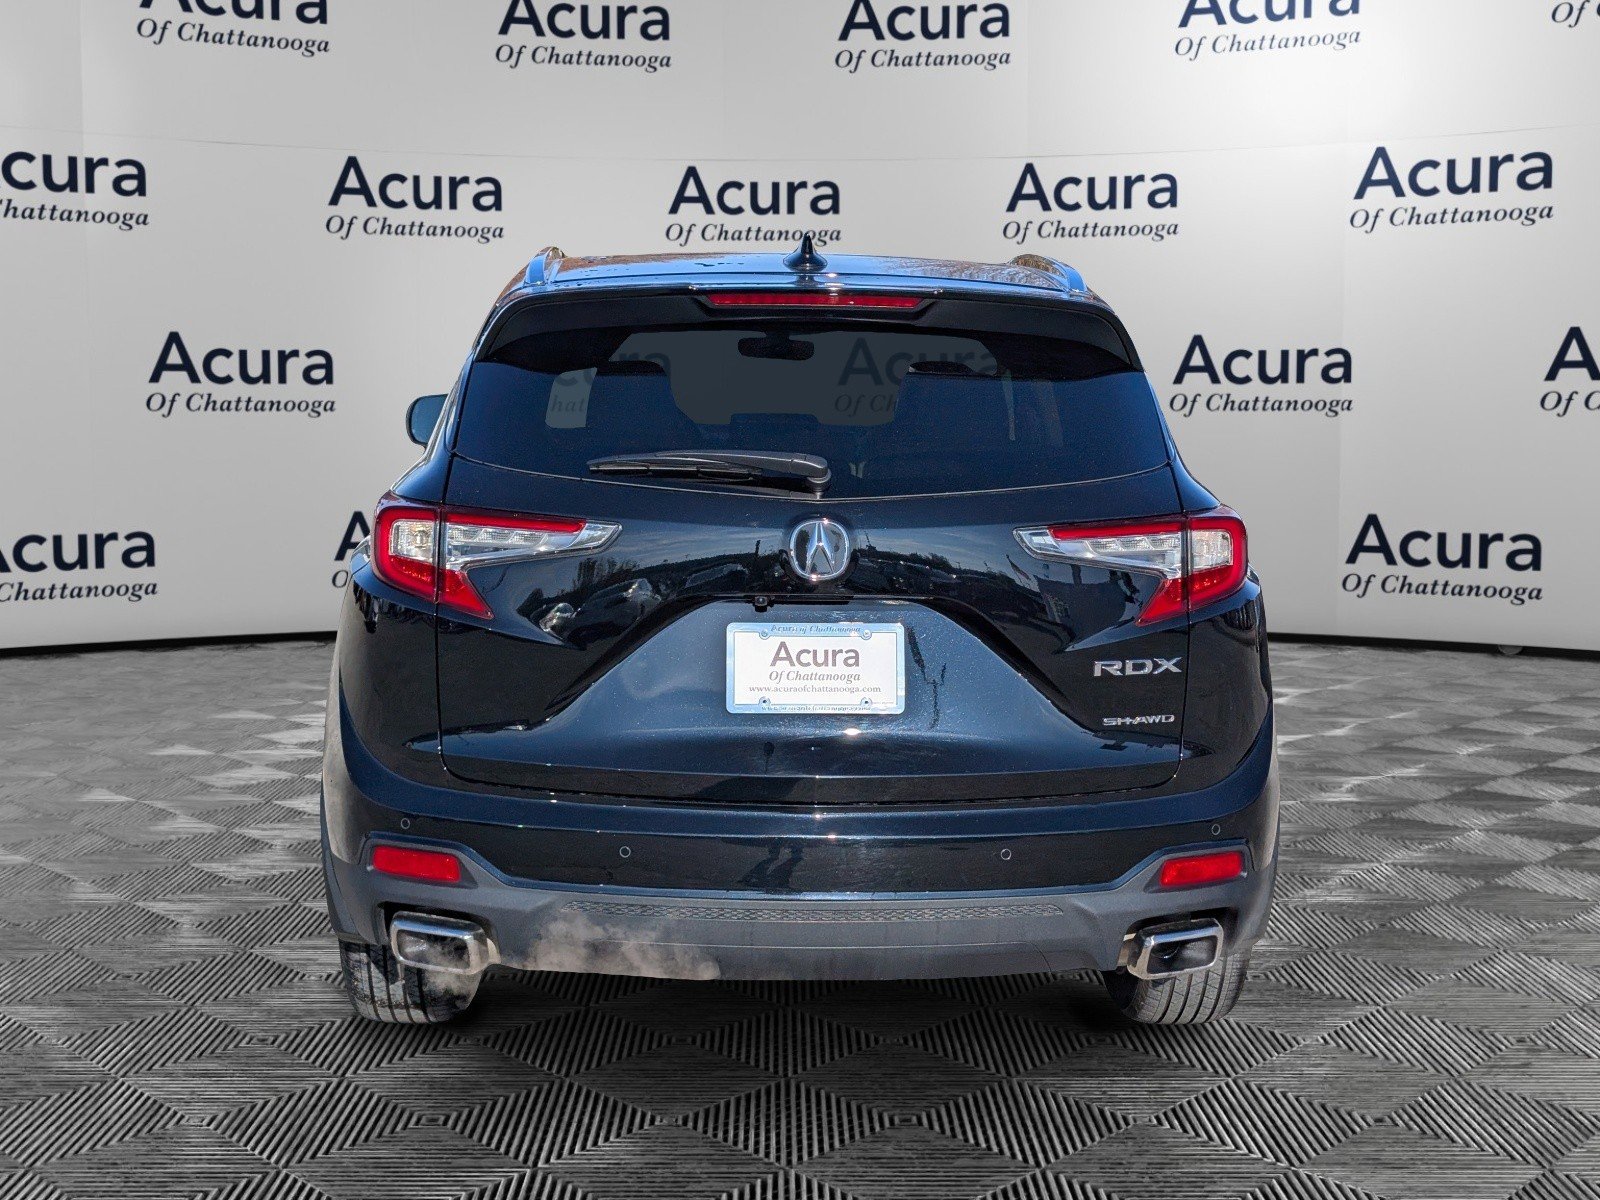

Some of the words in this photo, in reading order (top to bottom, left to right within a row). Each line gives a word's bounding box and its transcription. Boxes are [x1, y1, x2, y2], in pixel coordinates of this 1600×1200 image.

[140, 0, 328, 24] ura
[498, 0, 670, 41] Acura
[838, 0, 1010, 41] Acura
[1551, 0, 1590, 28] Of
[137, 18, 171, 45] Of
[177, 21, 330, 57] Chattanooga
[1175, 36, 1207, 61] Of
[1211, 31, 1361, 53] Chattanooga
[495, 44, 527, 69] Of
[531, 45, 672, 73] Chattanooga
[835, 49, 867, 73] Of
[870, 49, 1011, 71] Chattanooga
[0, 151, 147, 197] cura
[328, 155, 503, 212] Acura
[1353, 146, 1553, 199] Acura
[668, 165, 840, 215] Acura
[1005, 162, 1178, 213] Acura
[0, 198, 150, 231] hattanooga
[1349, 208, 1384, 234] Of
[1389, 205, 1554, 227] Chattanooga
[325, 215, 358, 240] Of
[363, 216, 505, 244] Chattanooga
[665, 223, 697, 247] Of
[1003, 221, 1033, 245] Of
[1037, 220, 1179, 242] Chattanooga
[148, 331, 335, 385] Acura
[1172, 334, 1353, 385] Acura
[145, 392, 182, 418] Of
[185, 392, 337, 418] Chattanooga
[1169, 393, 1203, 418] Of
[1206, 393, 1354, 418] Chattanooga
[1540, 390, 1579, 417] Of
[0, 531, 156, 573] cura
[1345, 513, 1543, 572] Acura
[0, 581, 158, 603] Chattanooga
[1341, 573, 1375, 598] Of
[1381, 574, 1544, 605] Chattanooga
[769, 641, 860, 668] Acura
[1093, 656, 1183, 677] RDX
[748, 684, 882, 694] www.acuraofchattanooga.com
[768, 670, 787, 683] Of
[786, 670, 861, 684] Chattanooga
